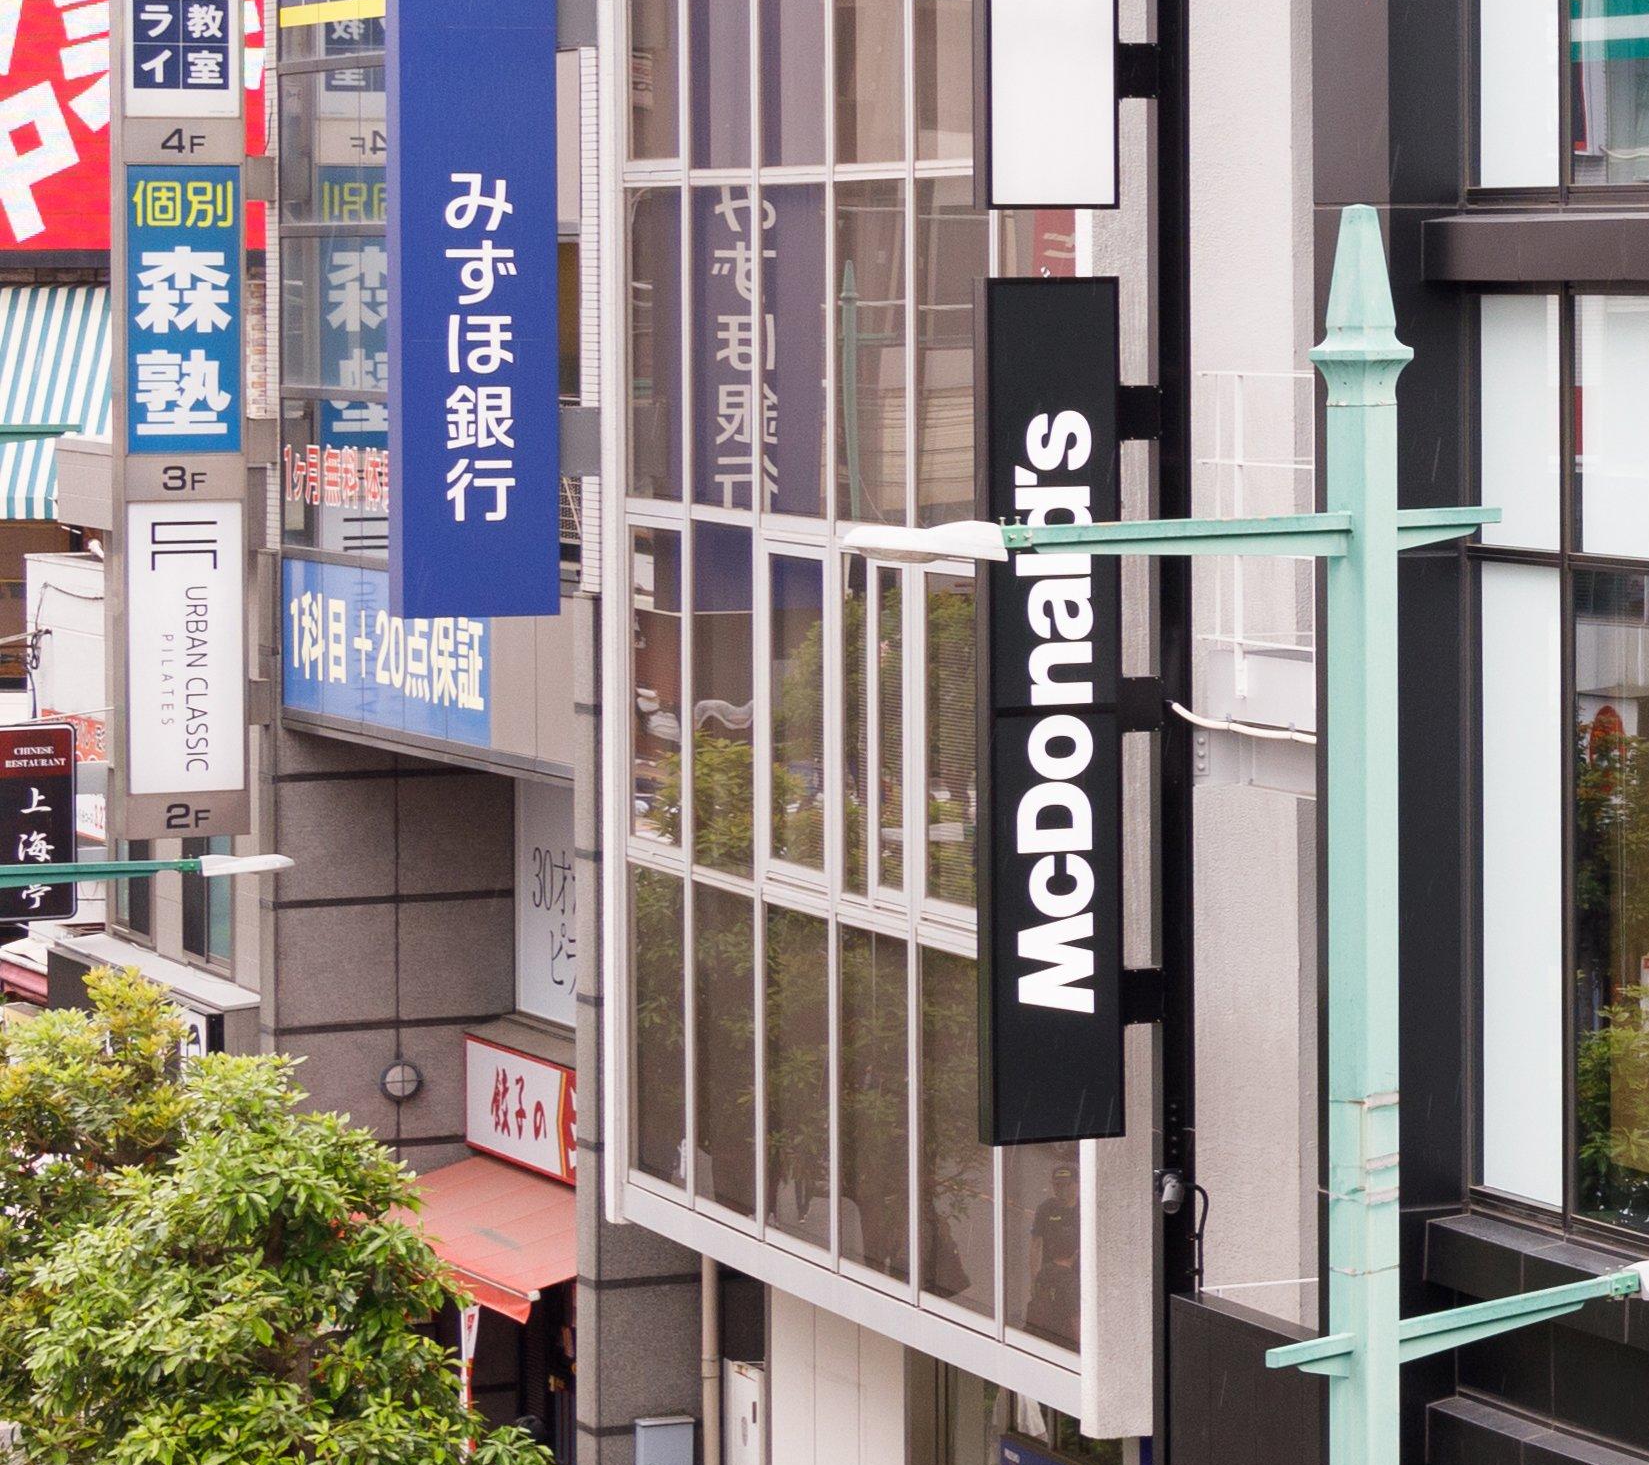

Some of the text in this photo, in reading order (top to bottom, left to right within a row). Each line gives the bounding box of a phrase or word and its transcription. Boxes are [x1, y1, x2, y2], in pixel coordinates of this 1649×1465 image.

[160, 128, 206, 154] 4F
[133, 180, 234, 228] 個別
[135, 246, 233, 435] 森塾
[443, 172, 518, 522] みずほ銀行
[162, 467, 207, 491] 3F
[283, 444, 389, 512] 1ヶ月無料体
[161, 633, 174, 727] PILATES
[185, 586, 209, 773] URBAN CLASSIC
[4, 756, 67, 770] RESTAURANT
[13, 744, 55, 757] CHINESE
[165, 803, 210, 829] 2F
[490, 1066, 548, 1141] 餃子の
